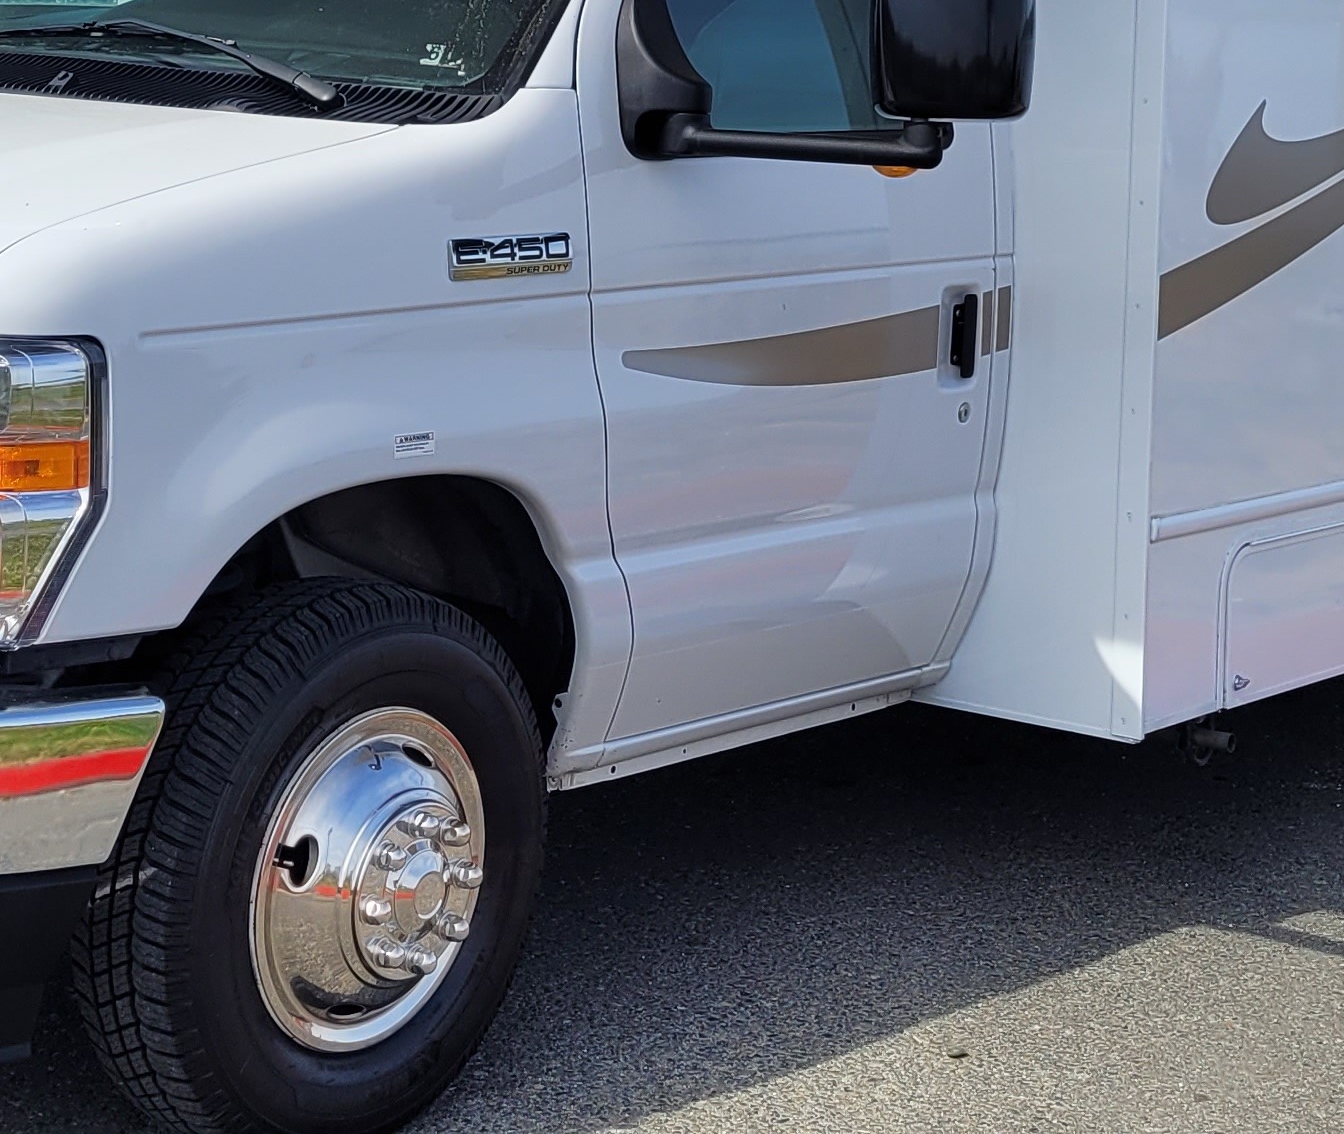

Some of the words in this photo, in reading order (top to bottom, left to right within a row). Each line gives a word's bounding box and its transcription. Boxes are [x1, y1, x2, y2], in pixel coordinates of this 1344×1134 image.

[452, 232, 570, 265] E-450
[506, 265, 540, 275] SUPER
[542, 263, 569, 272] DUTY
